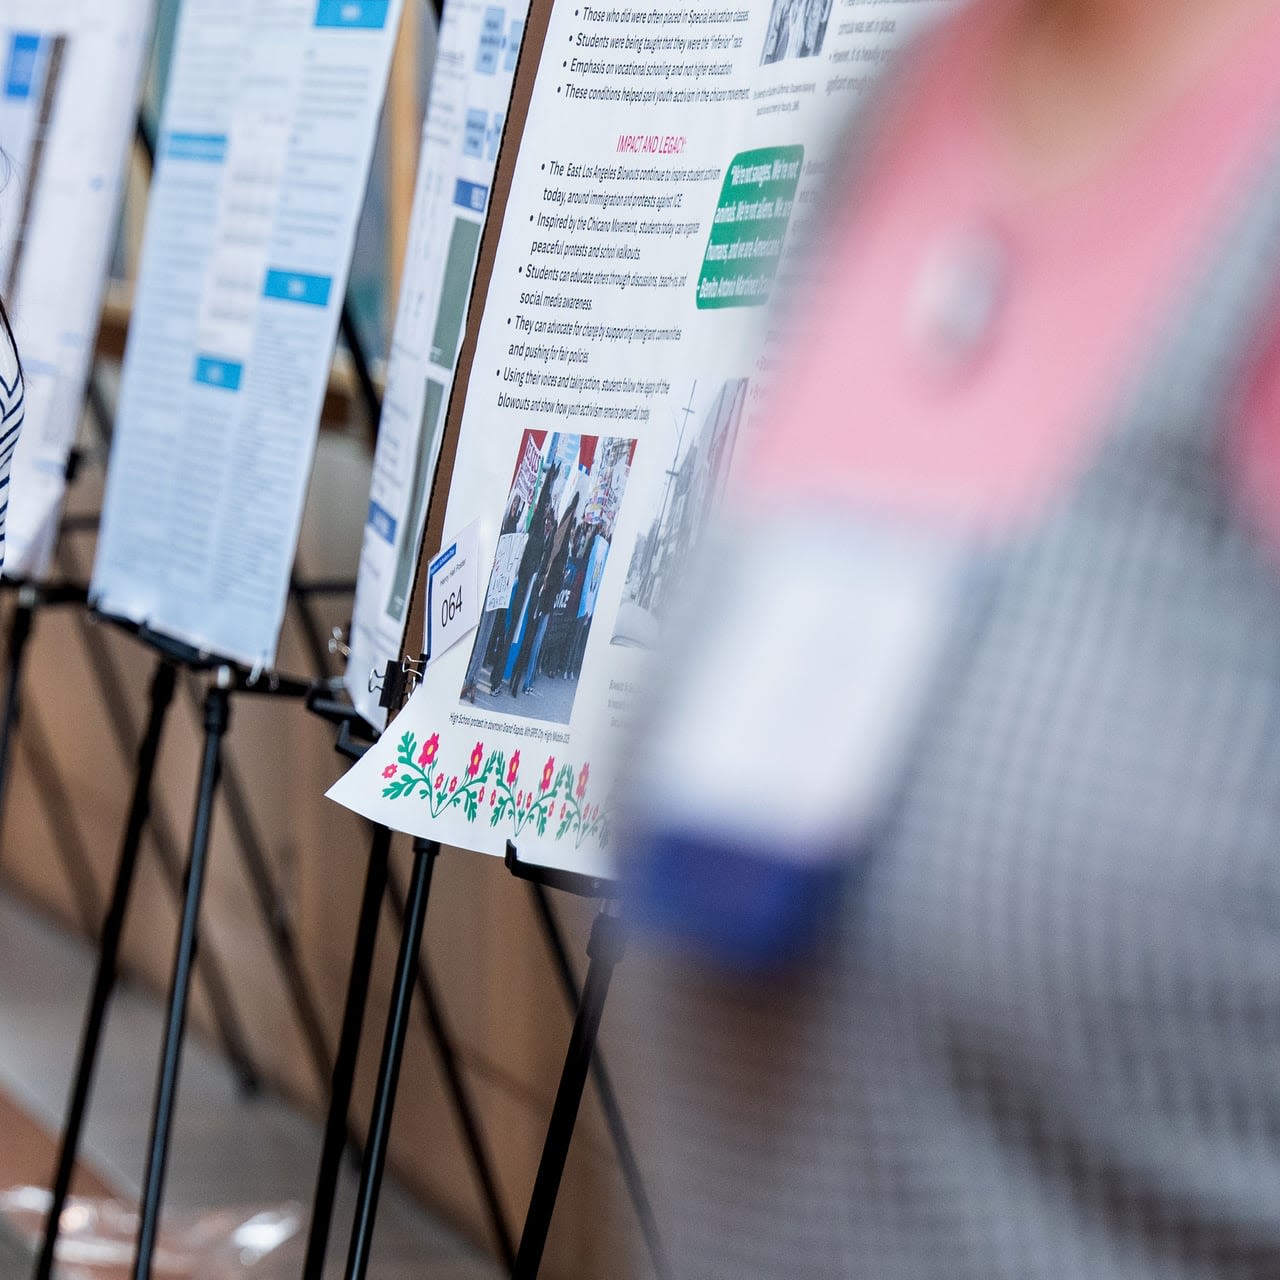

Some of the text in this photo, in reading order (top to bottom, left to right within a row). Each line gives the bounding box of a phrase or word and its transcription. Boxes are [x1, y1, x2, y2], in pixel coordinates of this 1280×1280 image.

[583, 6, 605, 22] Those
[606, 8, 620, 22] who
[620, 8, 631, 23] did
[631, 12, 647, 23] were
[647, 8, 663, 23] often
[662, 9, 682, 27] placed
[688, 7, 709, 27] Special
[709, 8, 733, 23] education
[576, 32, 710, 53] Students were being taught that they were the
[570, 58, 708, 80] Emphasis on vocational schooling and not higher
[565, 83, 588, 99] These
[589, 86, 621, 101] conditions
[621, 87, 643, 105] helped
[642, 88, 656, 105] spark
[655, 87, 673, 105] youth
[672, 88, 695, 102] activism
[616, 135, 644, 153] IMPACT
[642, 135, 658, 154] AND
[548, 161, 665, 183] The East Los Angeles Blowouts continue
[542, 187, 567, 205] today,
[567, 191, 591, 205] around
[590, 191, 624, 209] immigration
[623, 192, 633, 207] and
[632, 194, 657, 210] protests
[536, 212, 568, 231] Inspired
[568, 215, 577, 234] by
[576, 216, 587, 231] the
[586, 216, 611, 232] Chicano
[638, 220, 662, 235] students
[530, 239, 617, 259] peaceful protests and school
[525, 263, 631, 290] Students can educate others through
[519, 291, 543, 307] social
[543, 293, 562, 309] media
[515, 315, 534, 335] They
[534, 320, 547, 332] can
[546, 318, 574, 336] advocate
[573, 320, 584, 336] for
[605, 323, 634, 343] supporting
[508, 342, 570, 364] and pushing for fair
[503, 366, 525, 387] Using
[525, 369, 542, 385] their
[541, 371, 558, 387] voices
[557, 373, 569, 389] and
[569, 373, 585, 393] taking
[601, 376, 623, 393] students
[497, 392, 603, 419] blowouts and show how youth activism
[441, 584, 463, 628] 064
